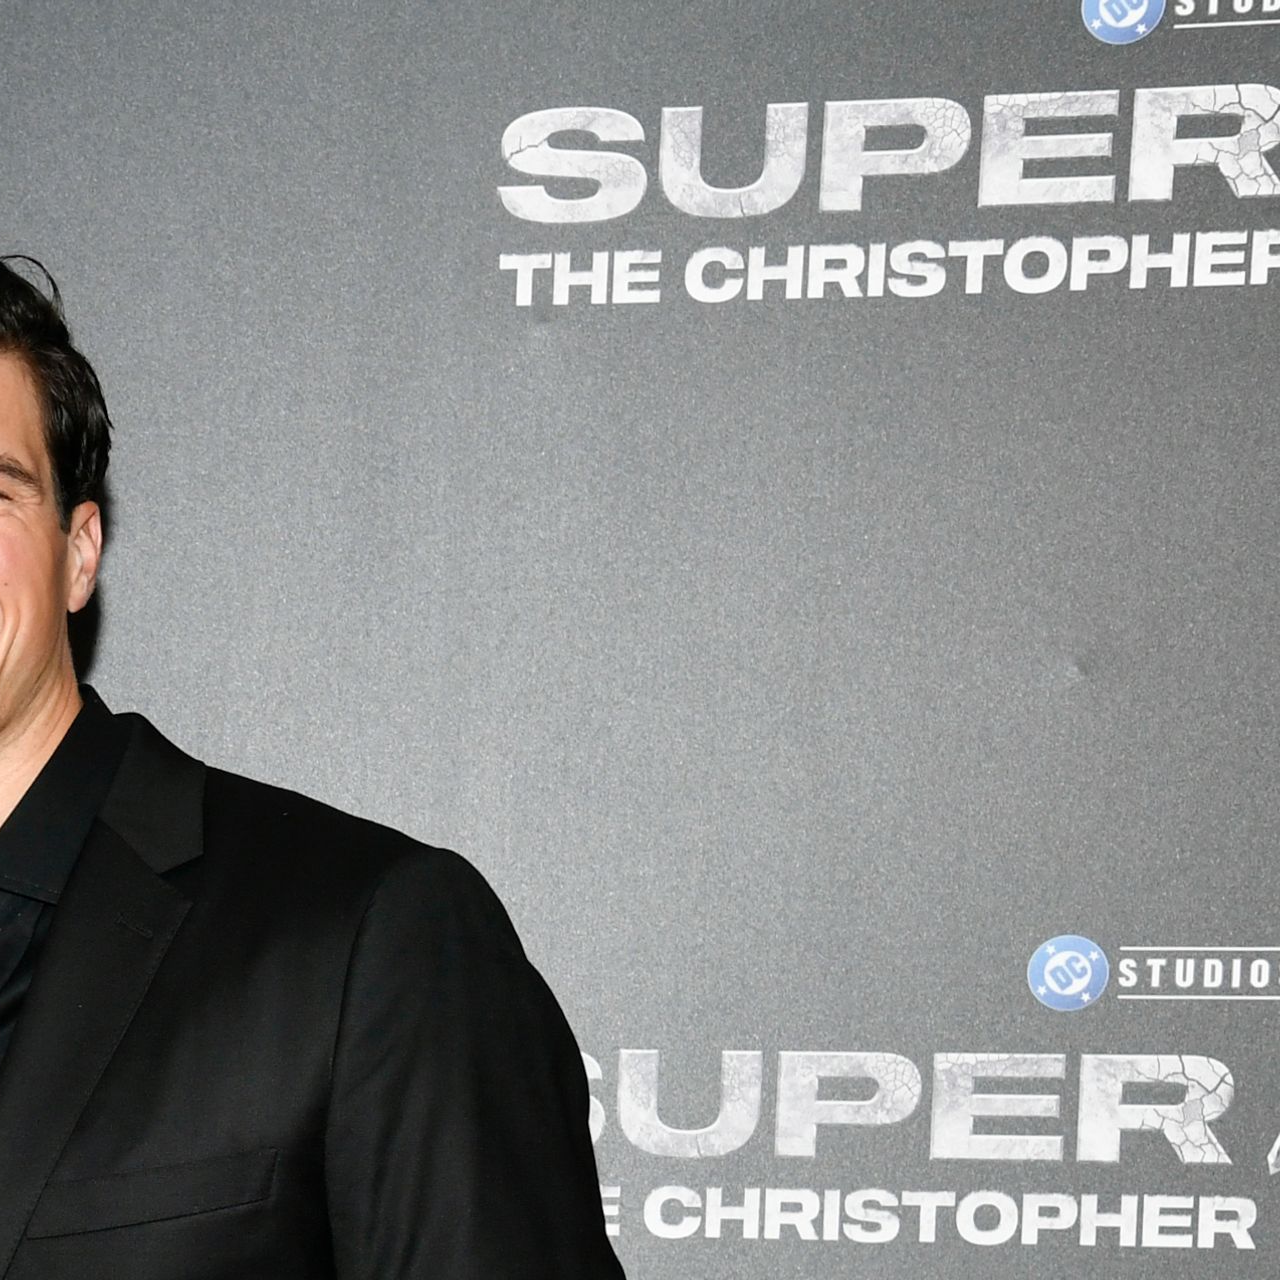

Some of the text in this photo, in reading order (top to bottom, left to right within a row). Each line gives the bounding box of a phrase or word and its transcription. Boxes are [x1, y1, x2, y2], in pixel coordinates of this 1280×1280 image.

[498, 249, 662, 307] THE
[1117, 958, 1280, 989] STUDIO
[643, 1184, 1257, 1251] CHRISTOPHER
